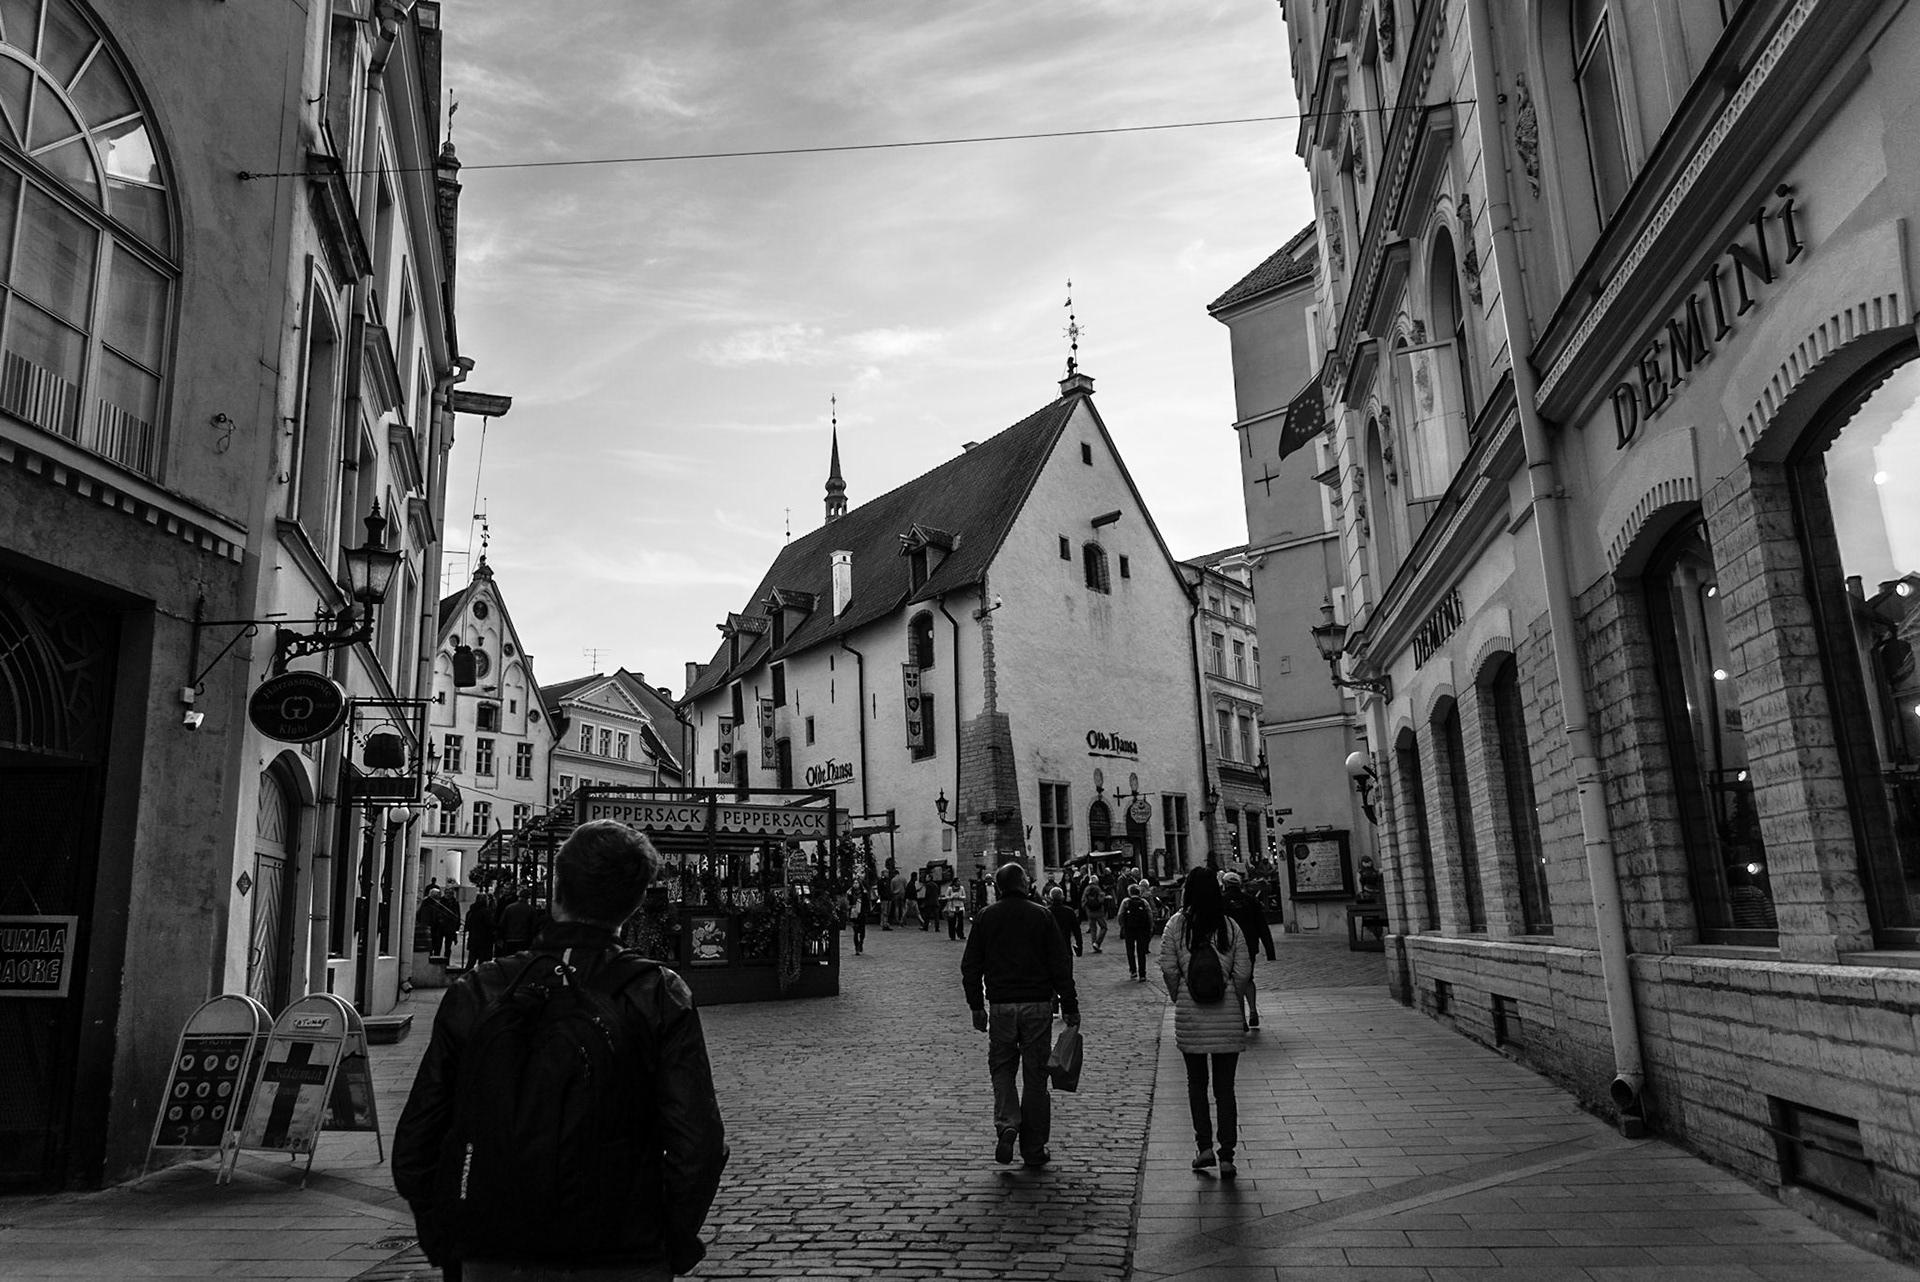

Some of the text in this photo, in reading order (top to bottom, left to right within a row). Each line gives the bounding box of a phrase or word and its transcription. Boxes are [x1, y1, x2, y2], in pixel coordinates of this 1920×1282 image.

[591, 804, 702, 824] PEPPERSACK
[722, 810, 827, 829] PEPPERSACK
[0, 928, 66, 953] UMAA
[0, 958, 61, 984] AOKE
